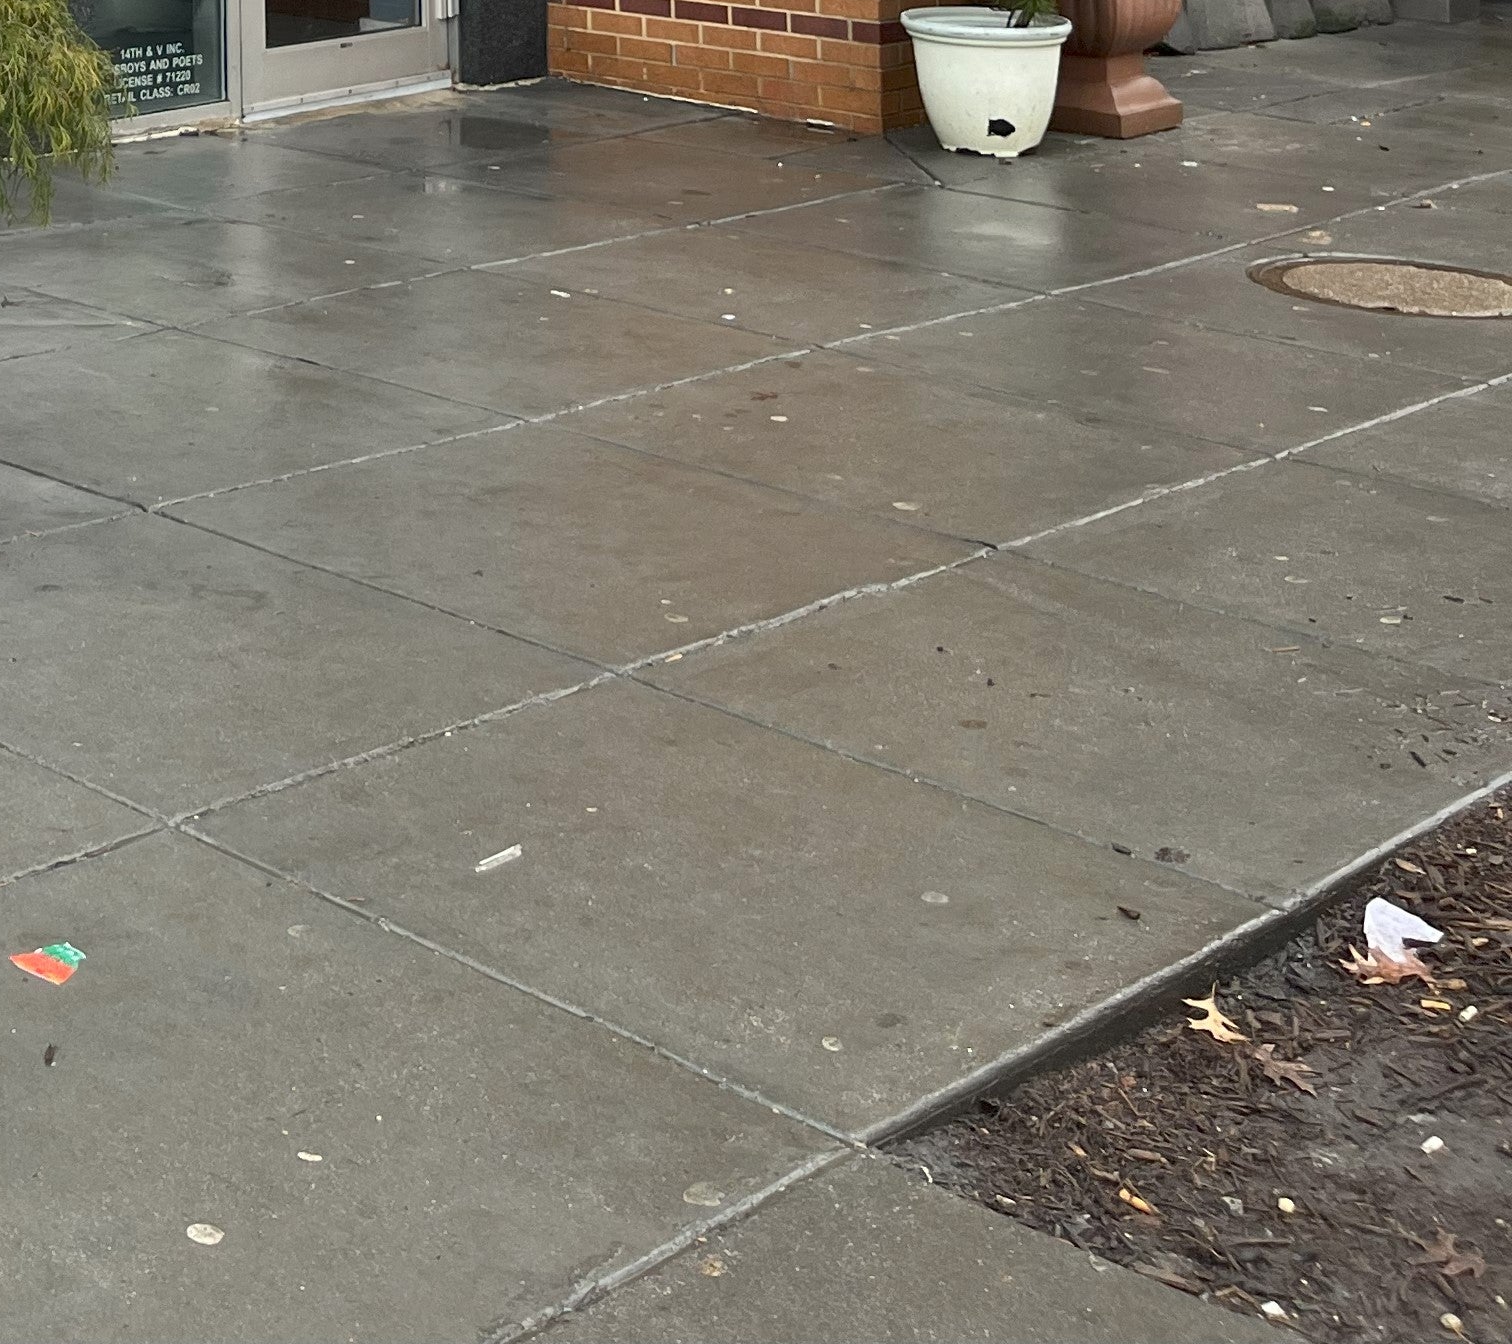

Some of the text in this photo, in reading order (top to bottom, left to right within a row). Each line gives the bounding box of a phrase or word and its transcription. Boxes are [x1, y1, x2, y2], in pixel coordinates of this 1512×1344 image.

[120, 42, 186, 60] 14TH & V INC.
[114, 53, 204, 75] SBOYS AND POETS
[165, 69, 192, 83] 71220
[139, 85, 174, 101] CLASS:
[176, 82, 201, 95] CR02
